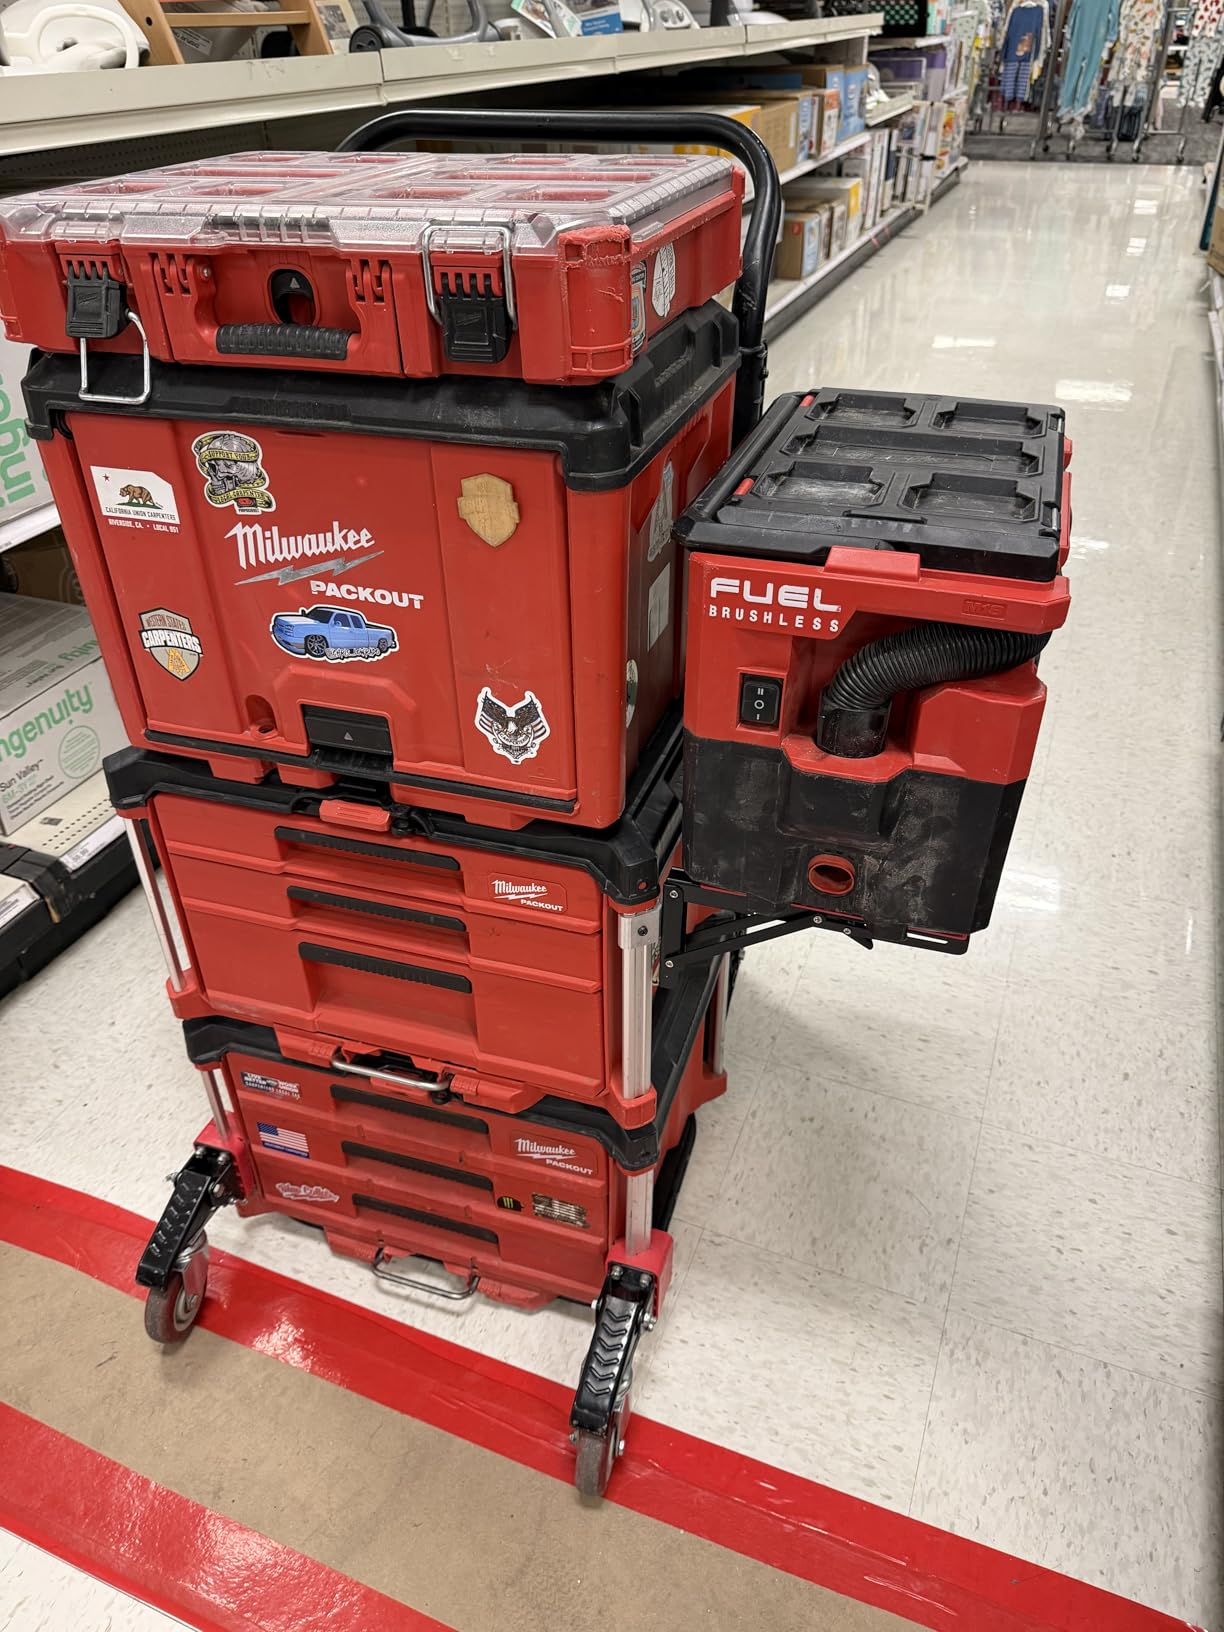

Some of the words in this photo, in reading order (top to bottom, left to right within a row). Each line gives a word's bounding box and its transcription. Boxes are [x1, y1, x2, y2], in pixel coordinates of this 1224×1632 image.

[105, 506, 132, 515] CALIFORNIA
[132, 510, 147, 518] UNION
[147, 511, 176, 521] CARPENTERS
[153, 523, 169, 532] LOCAL
[224, 521, 375, 570] Milwaukee
[310, 579, 424, 609] PACKOUT
[710, 577, 842, 613] FUEL
[709, 604, 839, 632] BRUSHLESS
[141, 629, 202, 653] CARPENTERS
[0, 777, 17, 793] Sun
[491, 879, 548, 895] Milwaukee
[520, 899, 563, 912] PACKOUT
[514, 1137, 577, 1155] Milwaukee
[545, 1158, 594, 1175] PACKOUT
